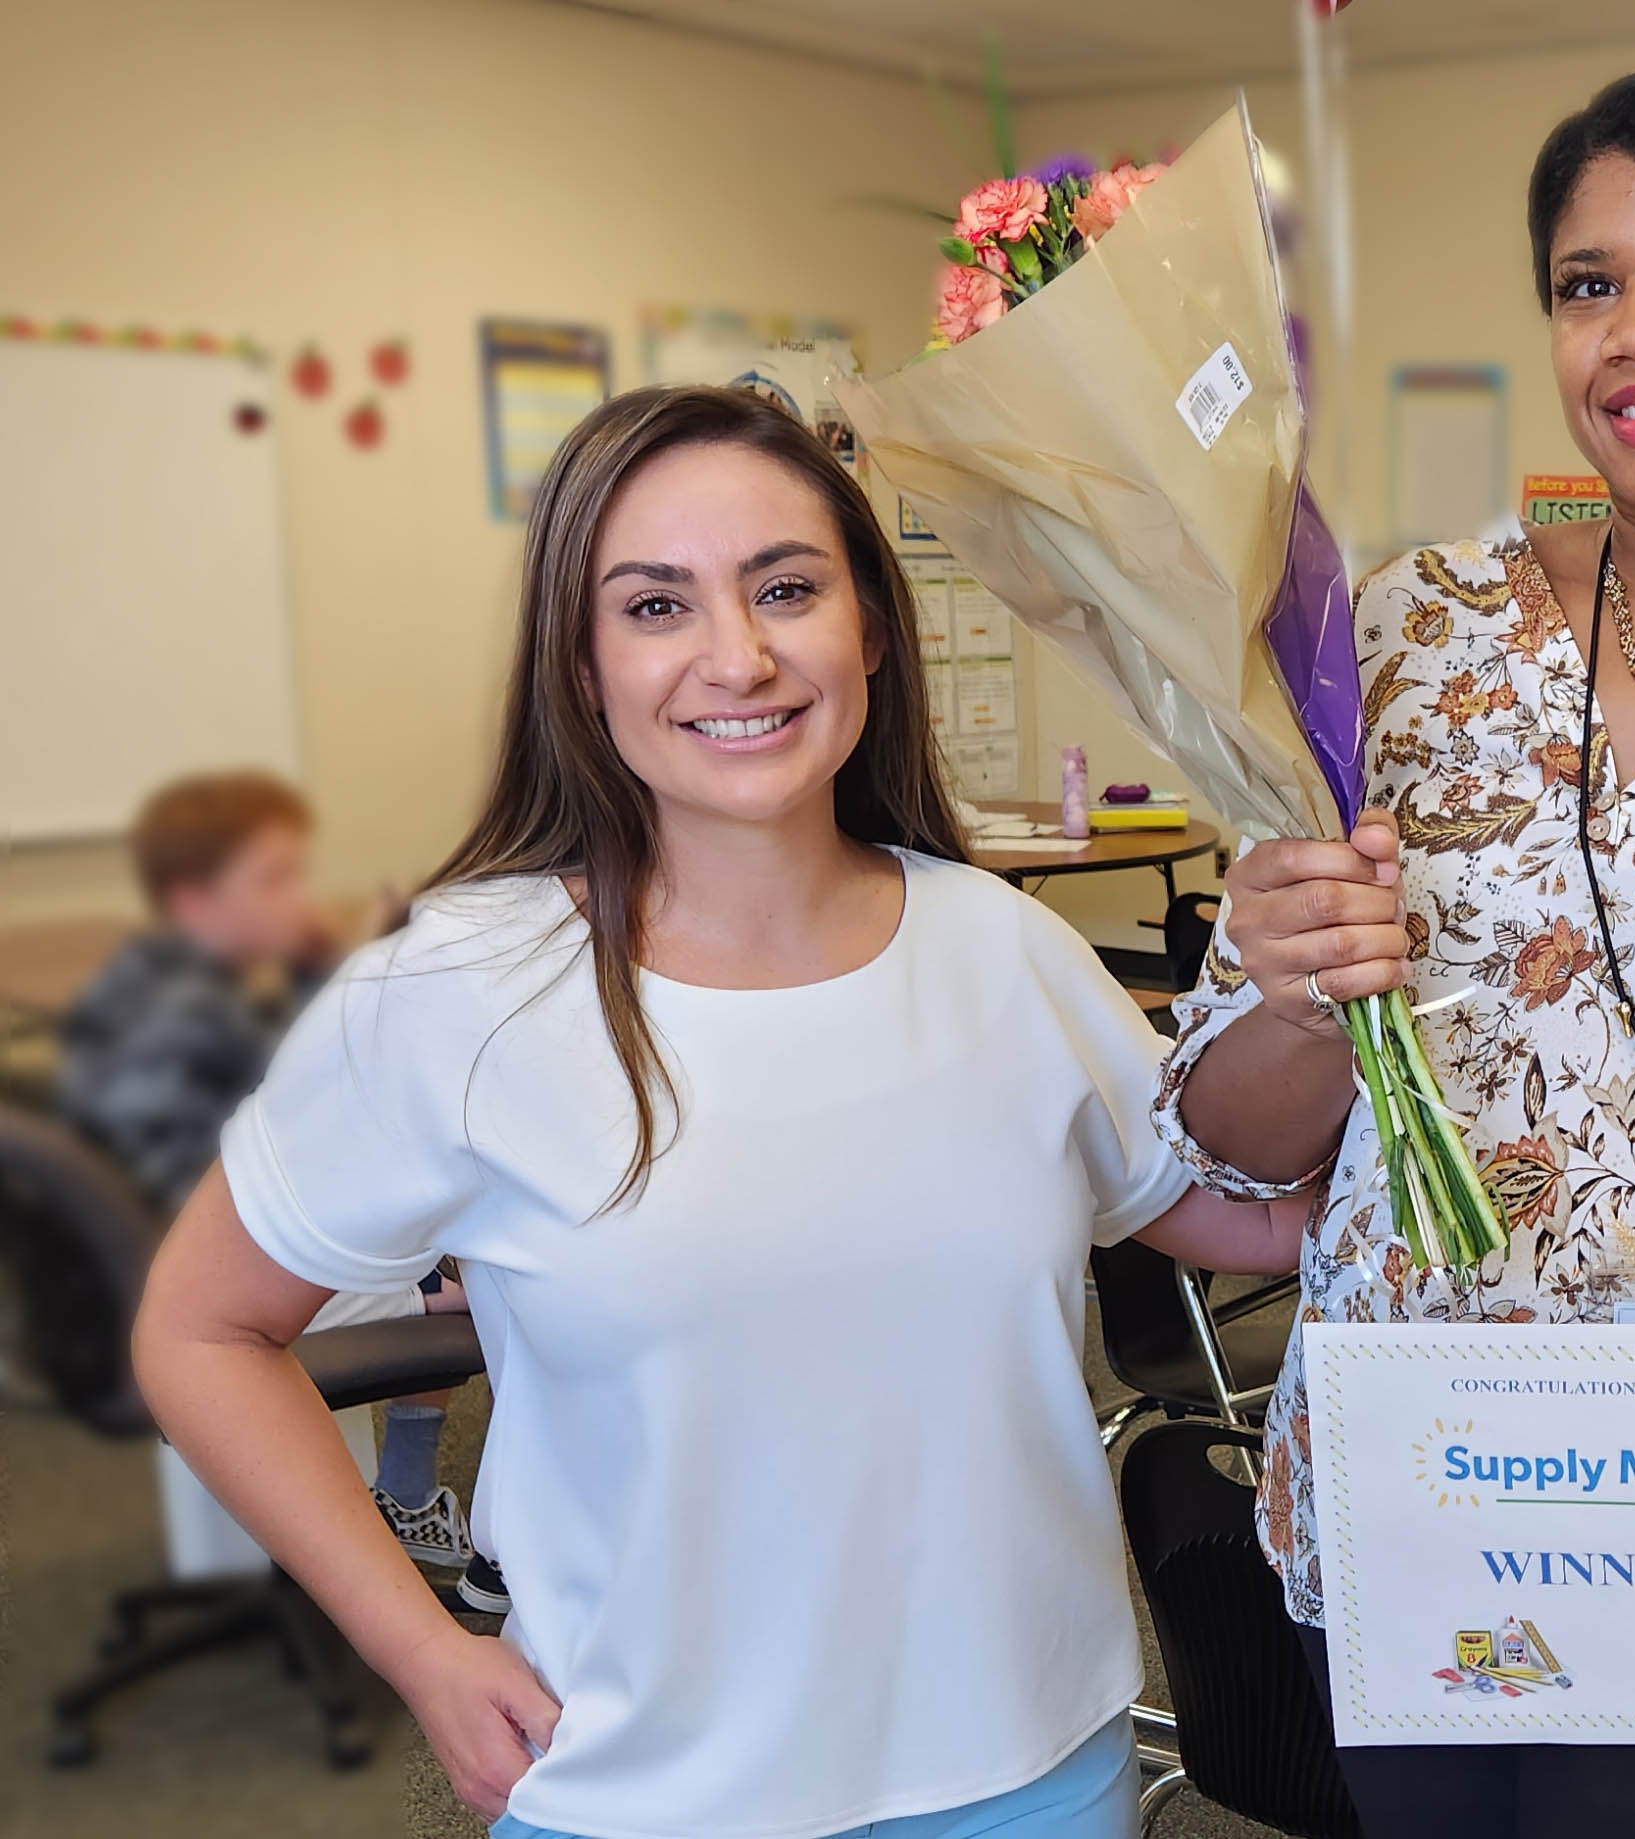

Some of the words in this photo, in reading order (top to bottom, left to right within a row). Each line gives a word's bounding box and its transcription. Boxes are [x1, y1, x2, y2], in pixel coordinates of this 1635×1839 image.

[1222, 355, 1244, 390] $12.00
[1528, 478, 1568, 492] Before
[1571, 481, 1593, 496] you
[1532, 502, 1612, 525] LISTE
[1444, 1444, 1608, 1492] Supply
